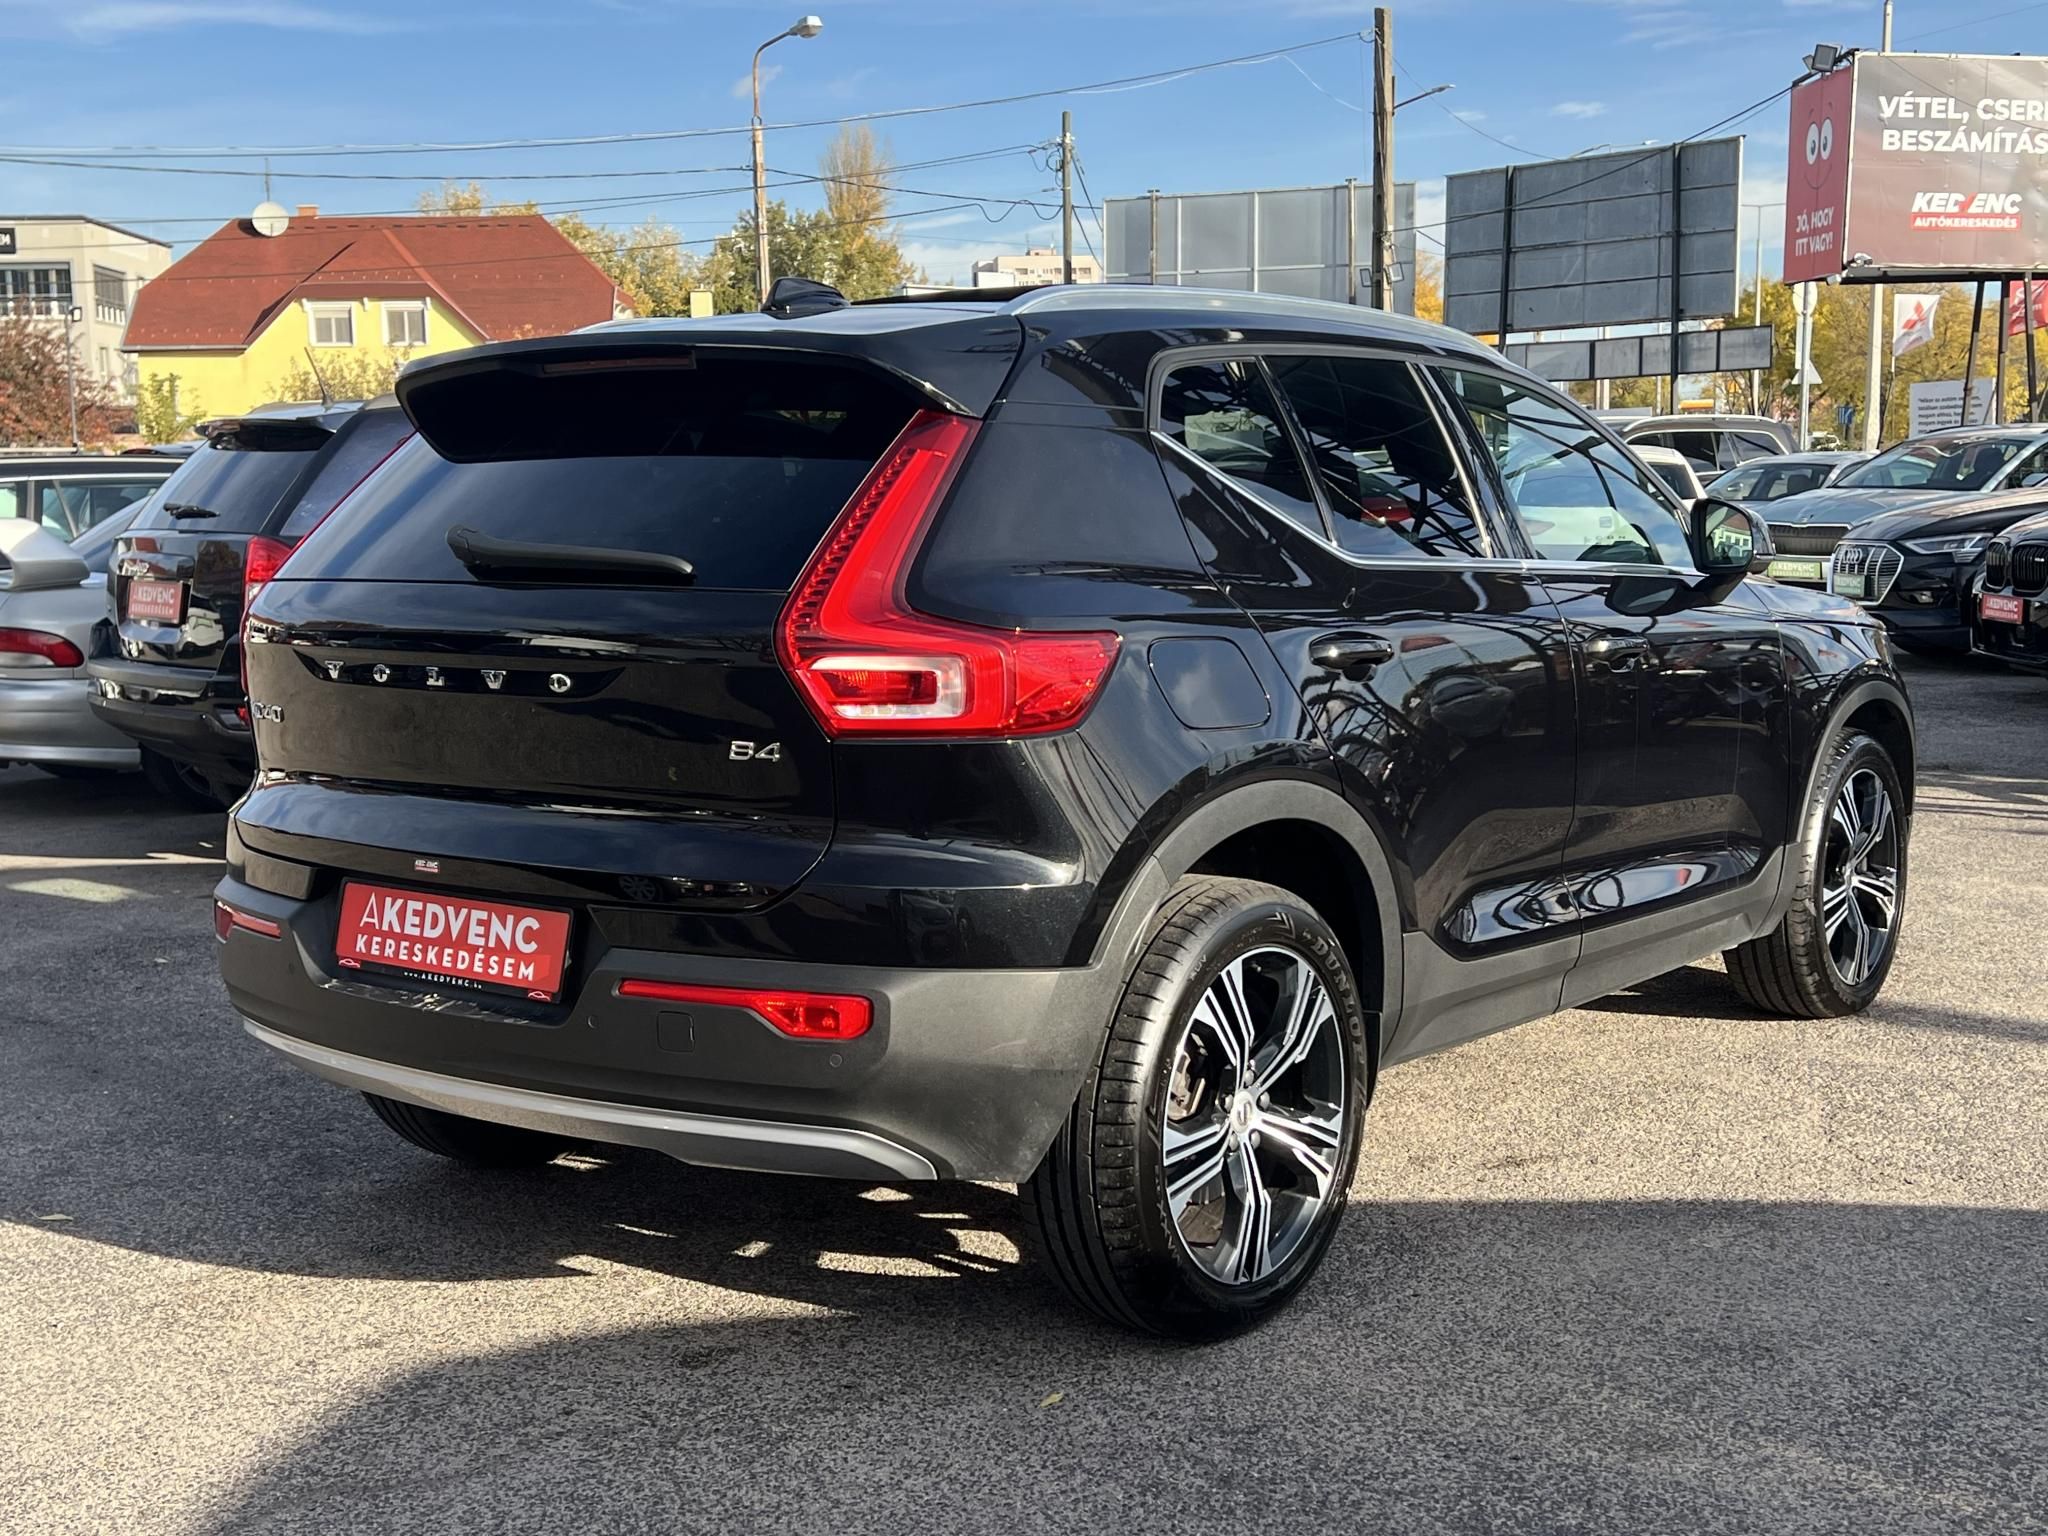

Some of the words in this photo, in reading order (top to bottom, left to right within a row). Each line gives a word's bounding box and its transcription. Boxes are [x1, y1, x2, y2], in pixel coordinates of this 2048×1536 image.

[1879, 91, 1969, 124] VÉTEL,
[1976, 98, 2048, 122] CSER
[1882, 126, 2048, 154] BESZÁMÍTÁS
[1796, 208, 1809, 234] JÓ,
[1811, 206, 1834, 229] HOGY
[1913, 215, 2018, 229] AUTÓKERESKEDÉS
[1795, 238, 1808, 257] ITT
[1809, 231, 1833, 254] VAGY!
[324, 660, 571, 693] VOLVO
[729, 740, 780, 762] B4
[355, 934, 535, 981] KERESKEDÉSEM
[1310, 936, 1365, 1064] DUNLOP
